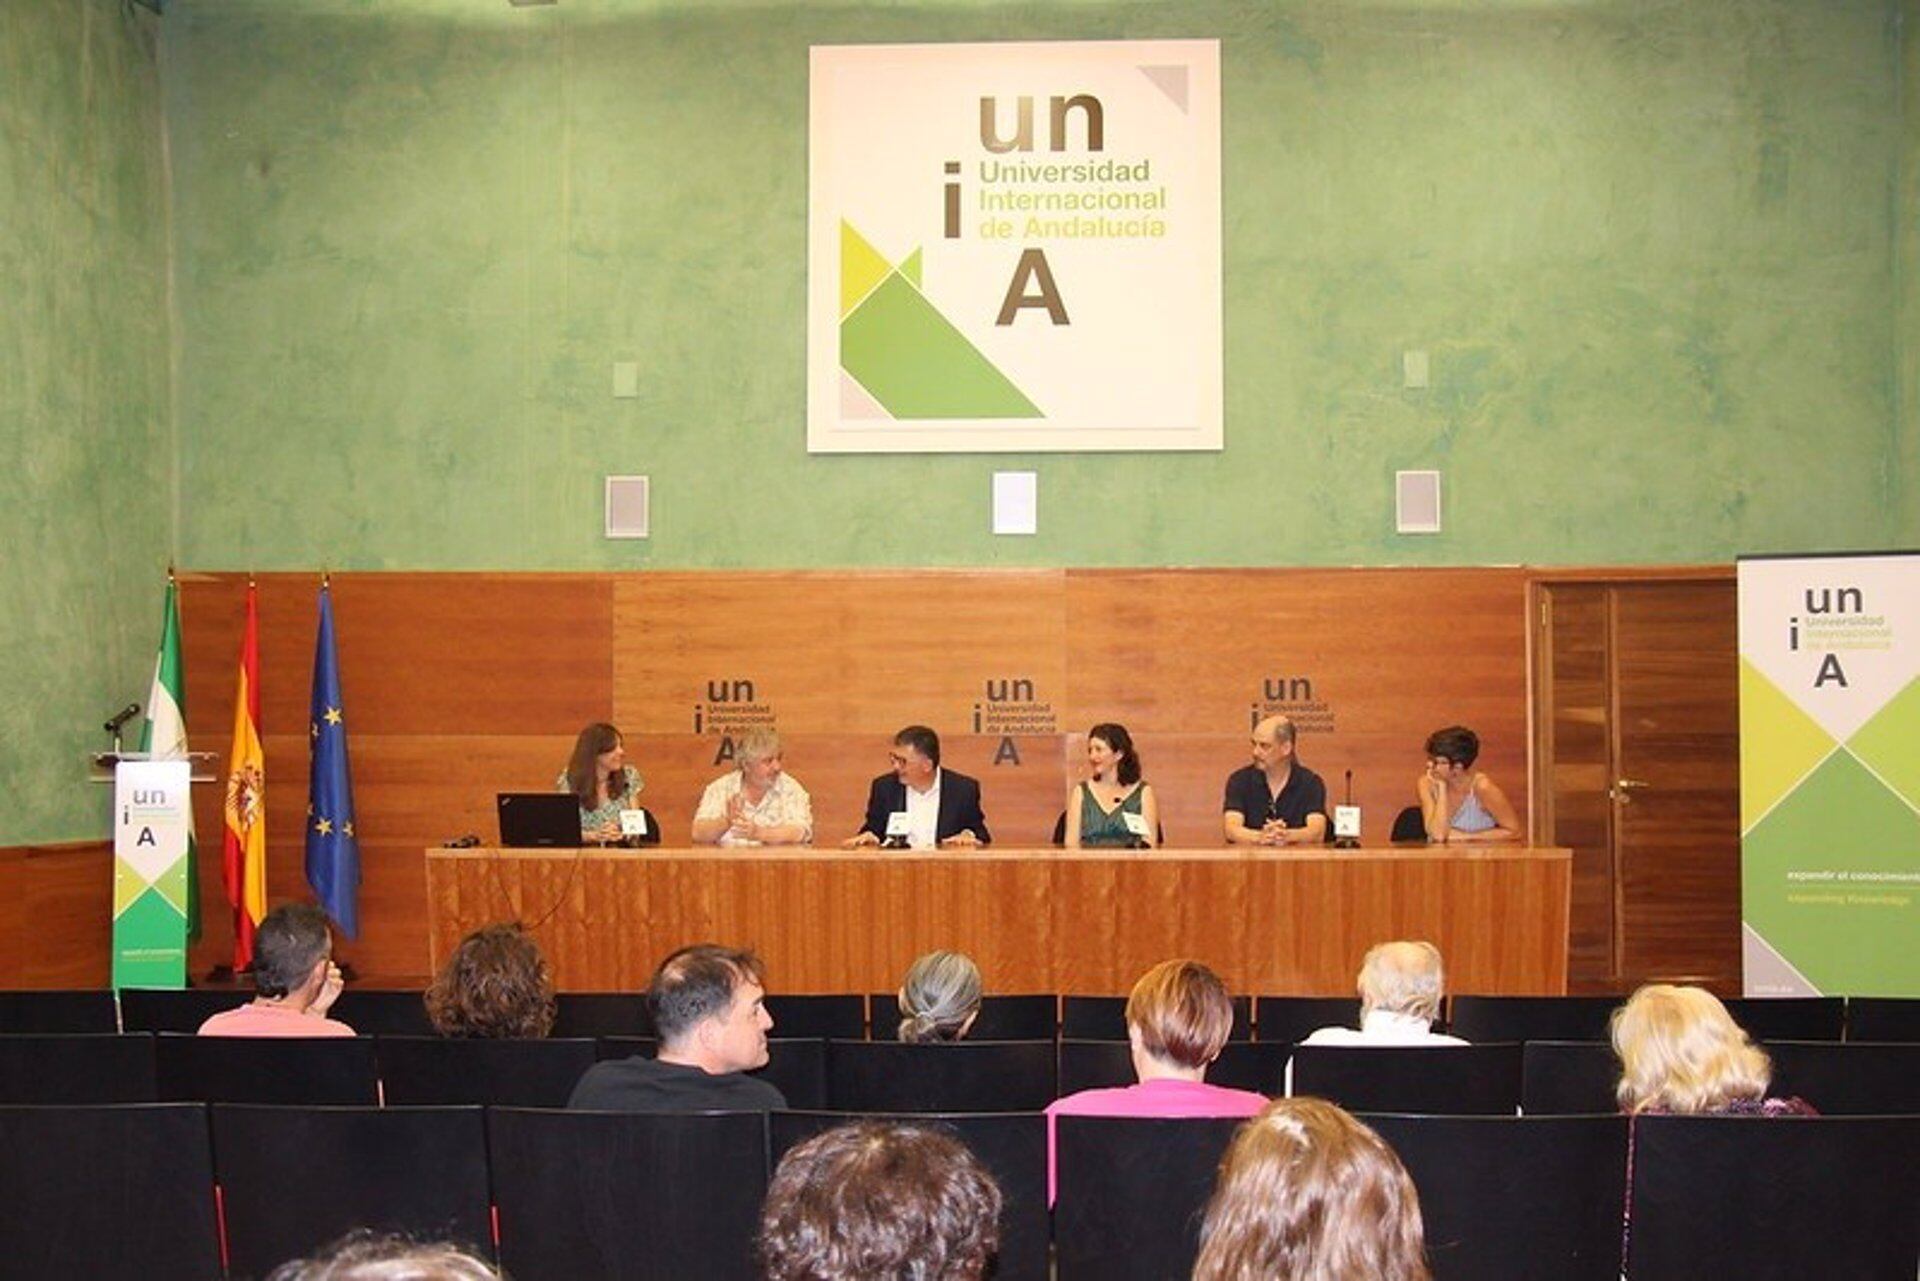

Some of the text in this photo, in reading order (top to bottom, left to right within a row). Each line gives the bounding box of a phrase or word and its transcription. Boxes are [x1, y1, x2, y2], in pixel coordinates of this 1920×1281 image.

[979, 93, 1104, 154] un
[979, 159, 1150, 184] Universidad
[944, 161, 961, 239] i
[979, 187, 1166, 211] Internacional
[979, 214, 1167, 239] de Andalucía
[994, 247, 1071, 326] A
[1805, 587, 1863, 614] un
[1790, 617, 1798, 651] i
[1814, 653, 1848, 688] A
[707, 680, 754, 702] un
[986, 679, 1034, 702] un
[1264, 678, 1311, 701] un
[695, 704, 702, 734] i
[974, 704, 981, 733] i
[987, 704, 1051, 713] Universidad
[714, 737, 736, 766] A
[993, 736, 1020, 766] A
[133, 789, 166, 805] un
[136, 826, 156, 847] A
